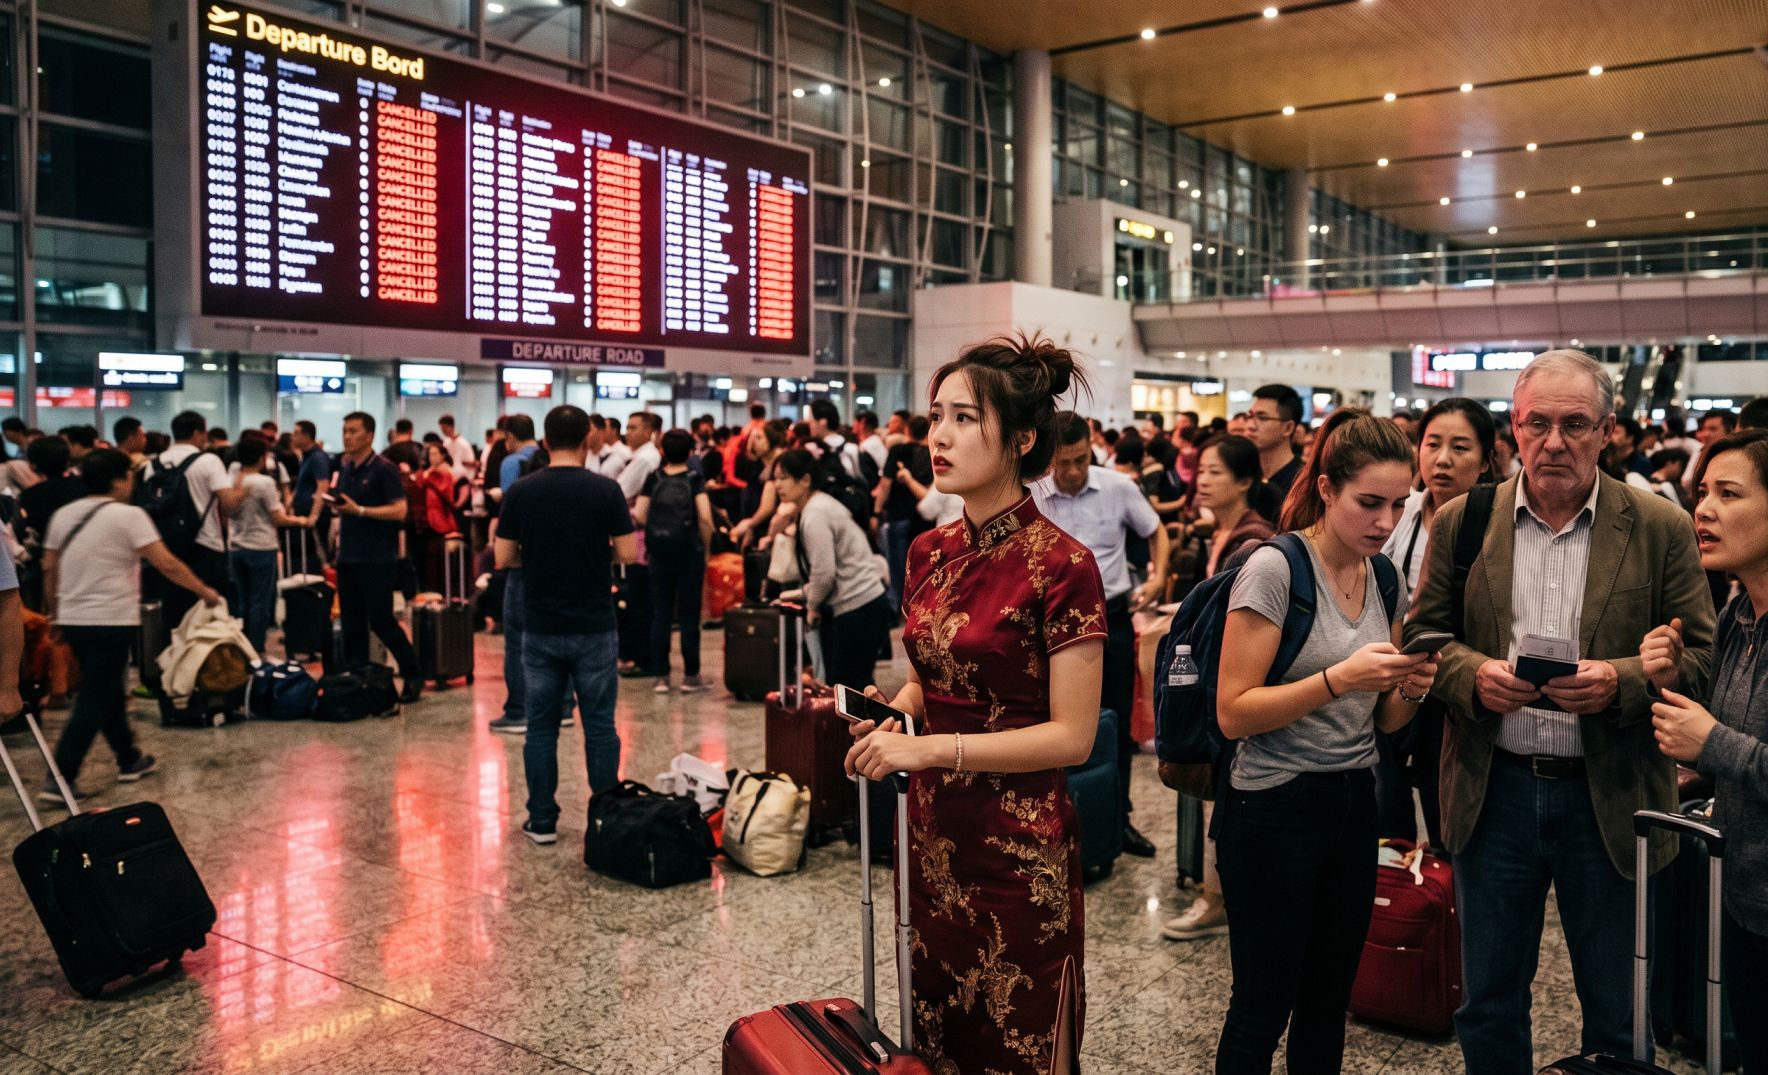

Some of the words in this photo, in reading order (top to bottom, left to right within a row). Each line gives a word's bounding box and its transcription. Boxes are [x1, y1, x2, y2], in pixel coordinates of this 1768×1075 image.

[246, 13, 367, 66] Departure
[371, 45, 424, 80] Bord
[512, 342, 601, 361] DEPARTURE
[606, 348, 644, 364] ROAD
